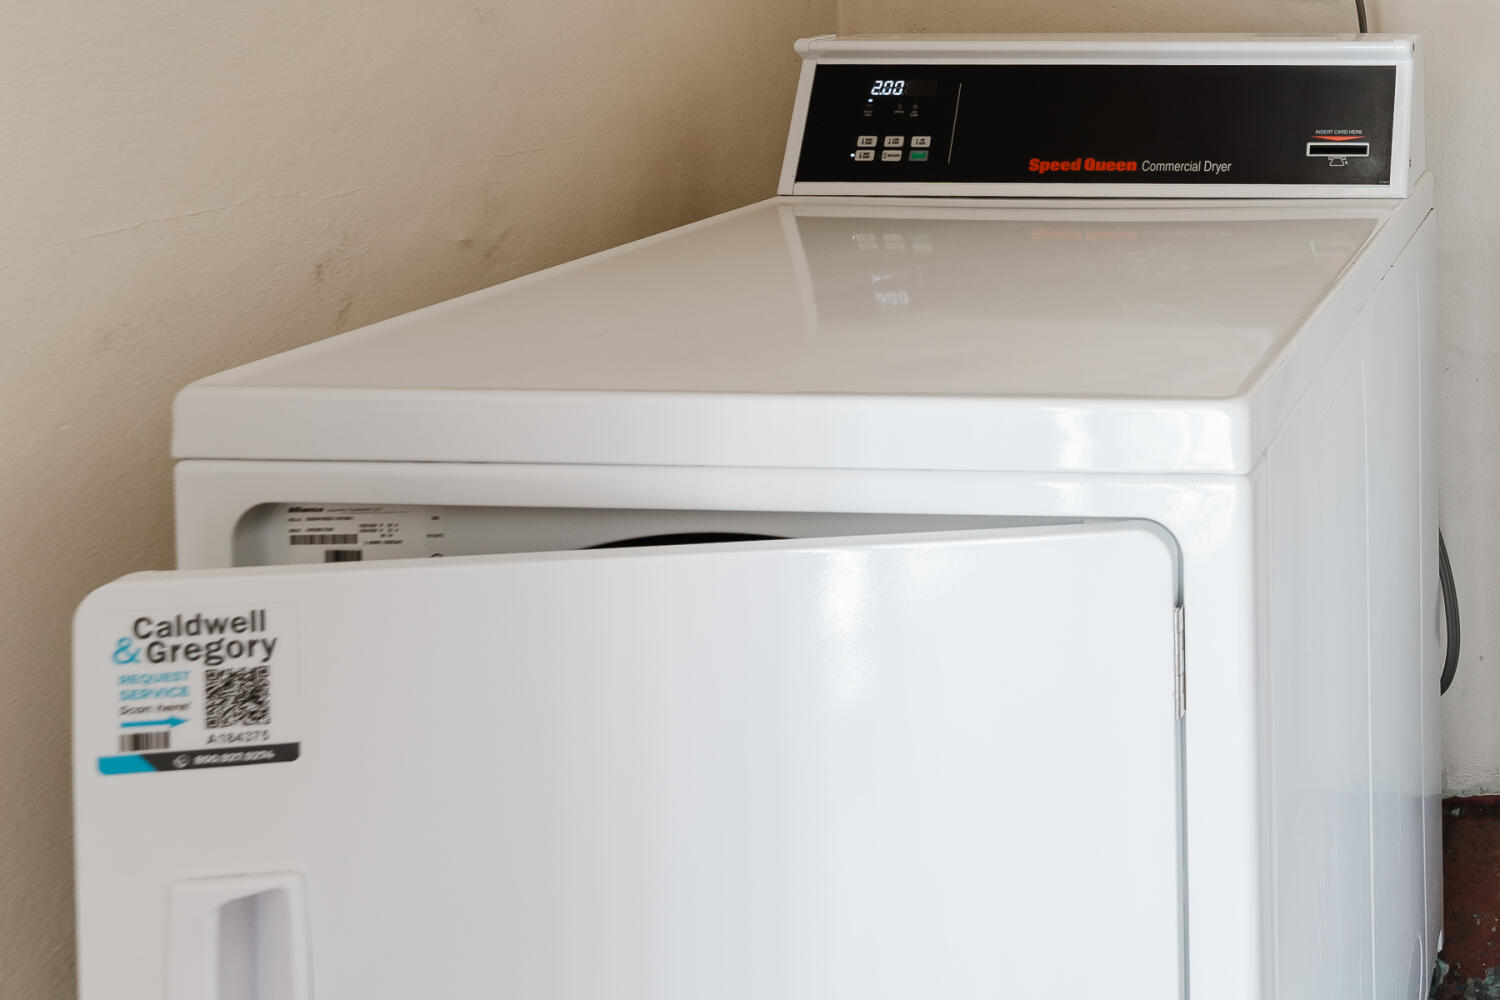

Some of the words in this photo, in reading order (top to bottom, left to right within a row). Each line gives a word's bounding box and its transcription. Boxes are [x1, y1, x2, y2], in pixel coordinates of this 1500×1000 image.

[871, 80, 905, 96] 2.00
[1028, 157, 1082, 175] Speed
[1084, 157, 1137, 172] Queen
[1141, 160, 1201, 172] Commercial
[1203, 160, 1232, 175] Dryer
[133, 609, 266, 640] Caldwell
[118, 670, 192, 685] REQUEST
[118, 686, 191, 701] SERVICE
[119, 705, 152, 715] Scan
